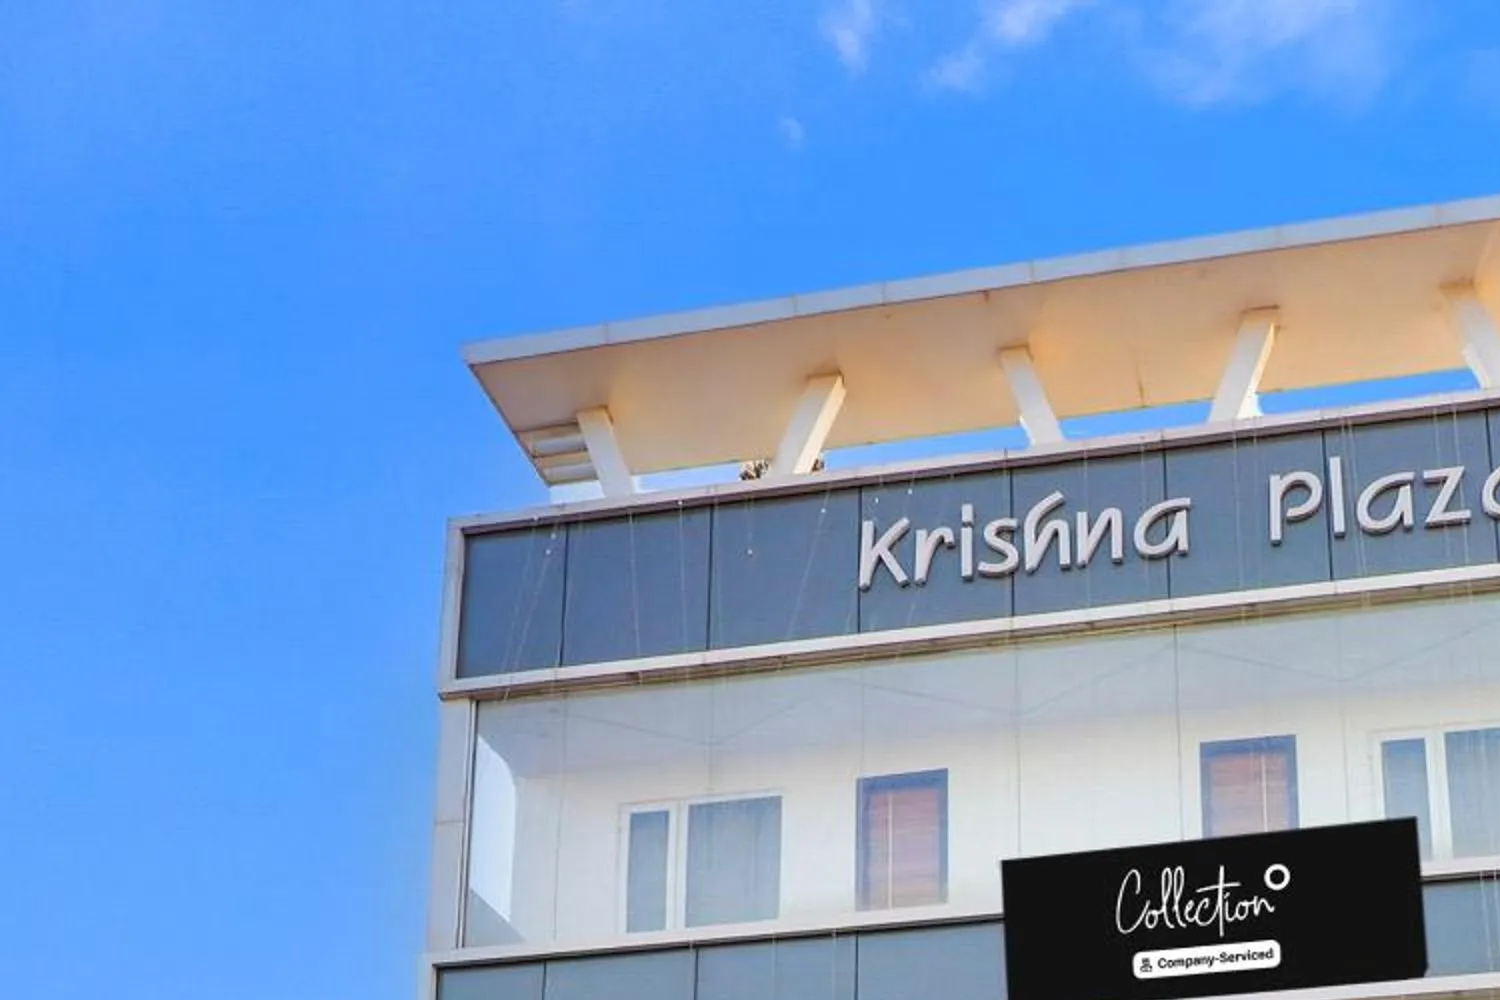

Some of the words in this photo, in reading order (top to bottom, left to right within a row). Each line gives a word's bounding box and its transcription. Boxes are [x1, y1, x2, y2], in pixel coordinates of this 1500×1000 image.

[858, 491, 1191, 590] Krishna
[1116, 865, 1275, 937] Collection
[1157, 947, 1274, 970] Company-Serviced
